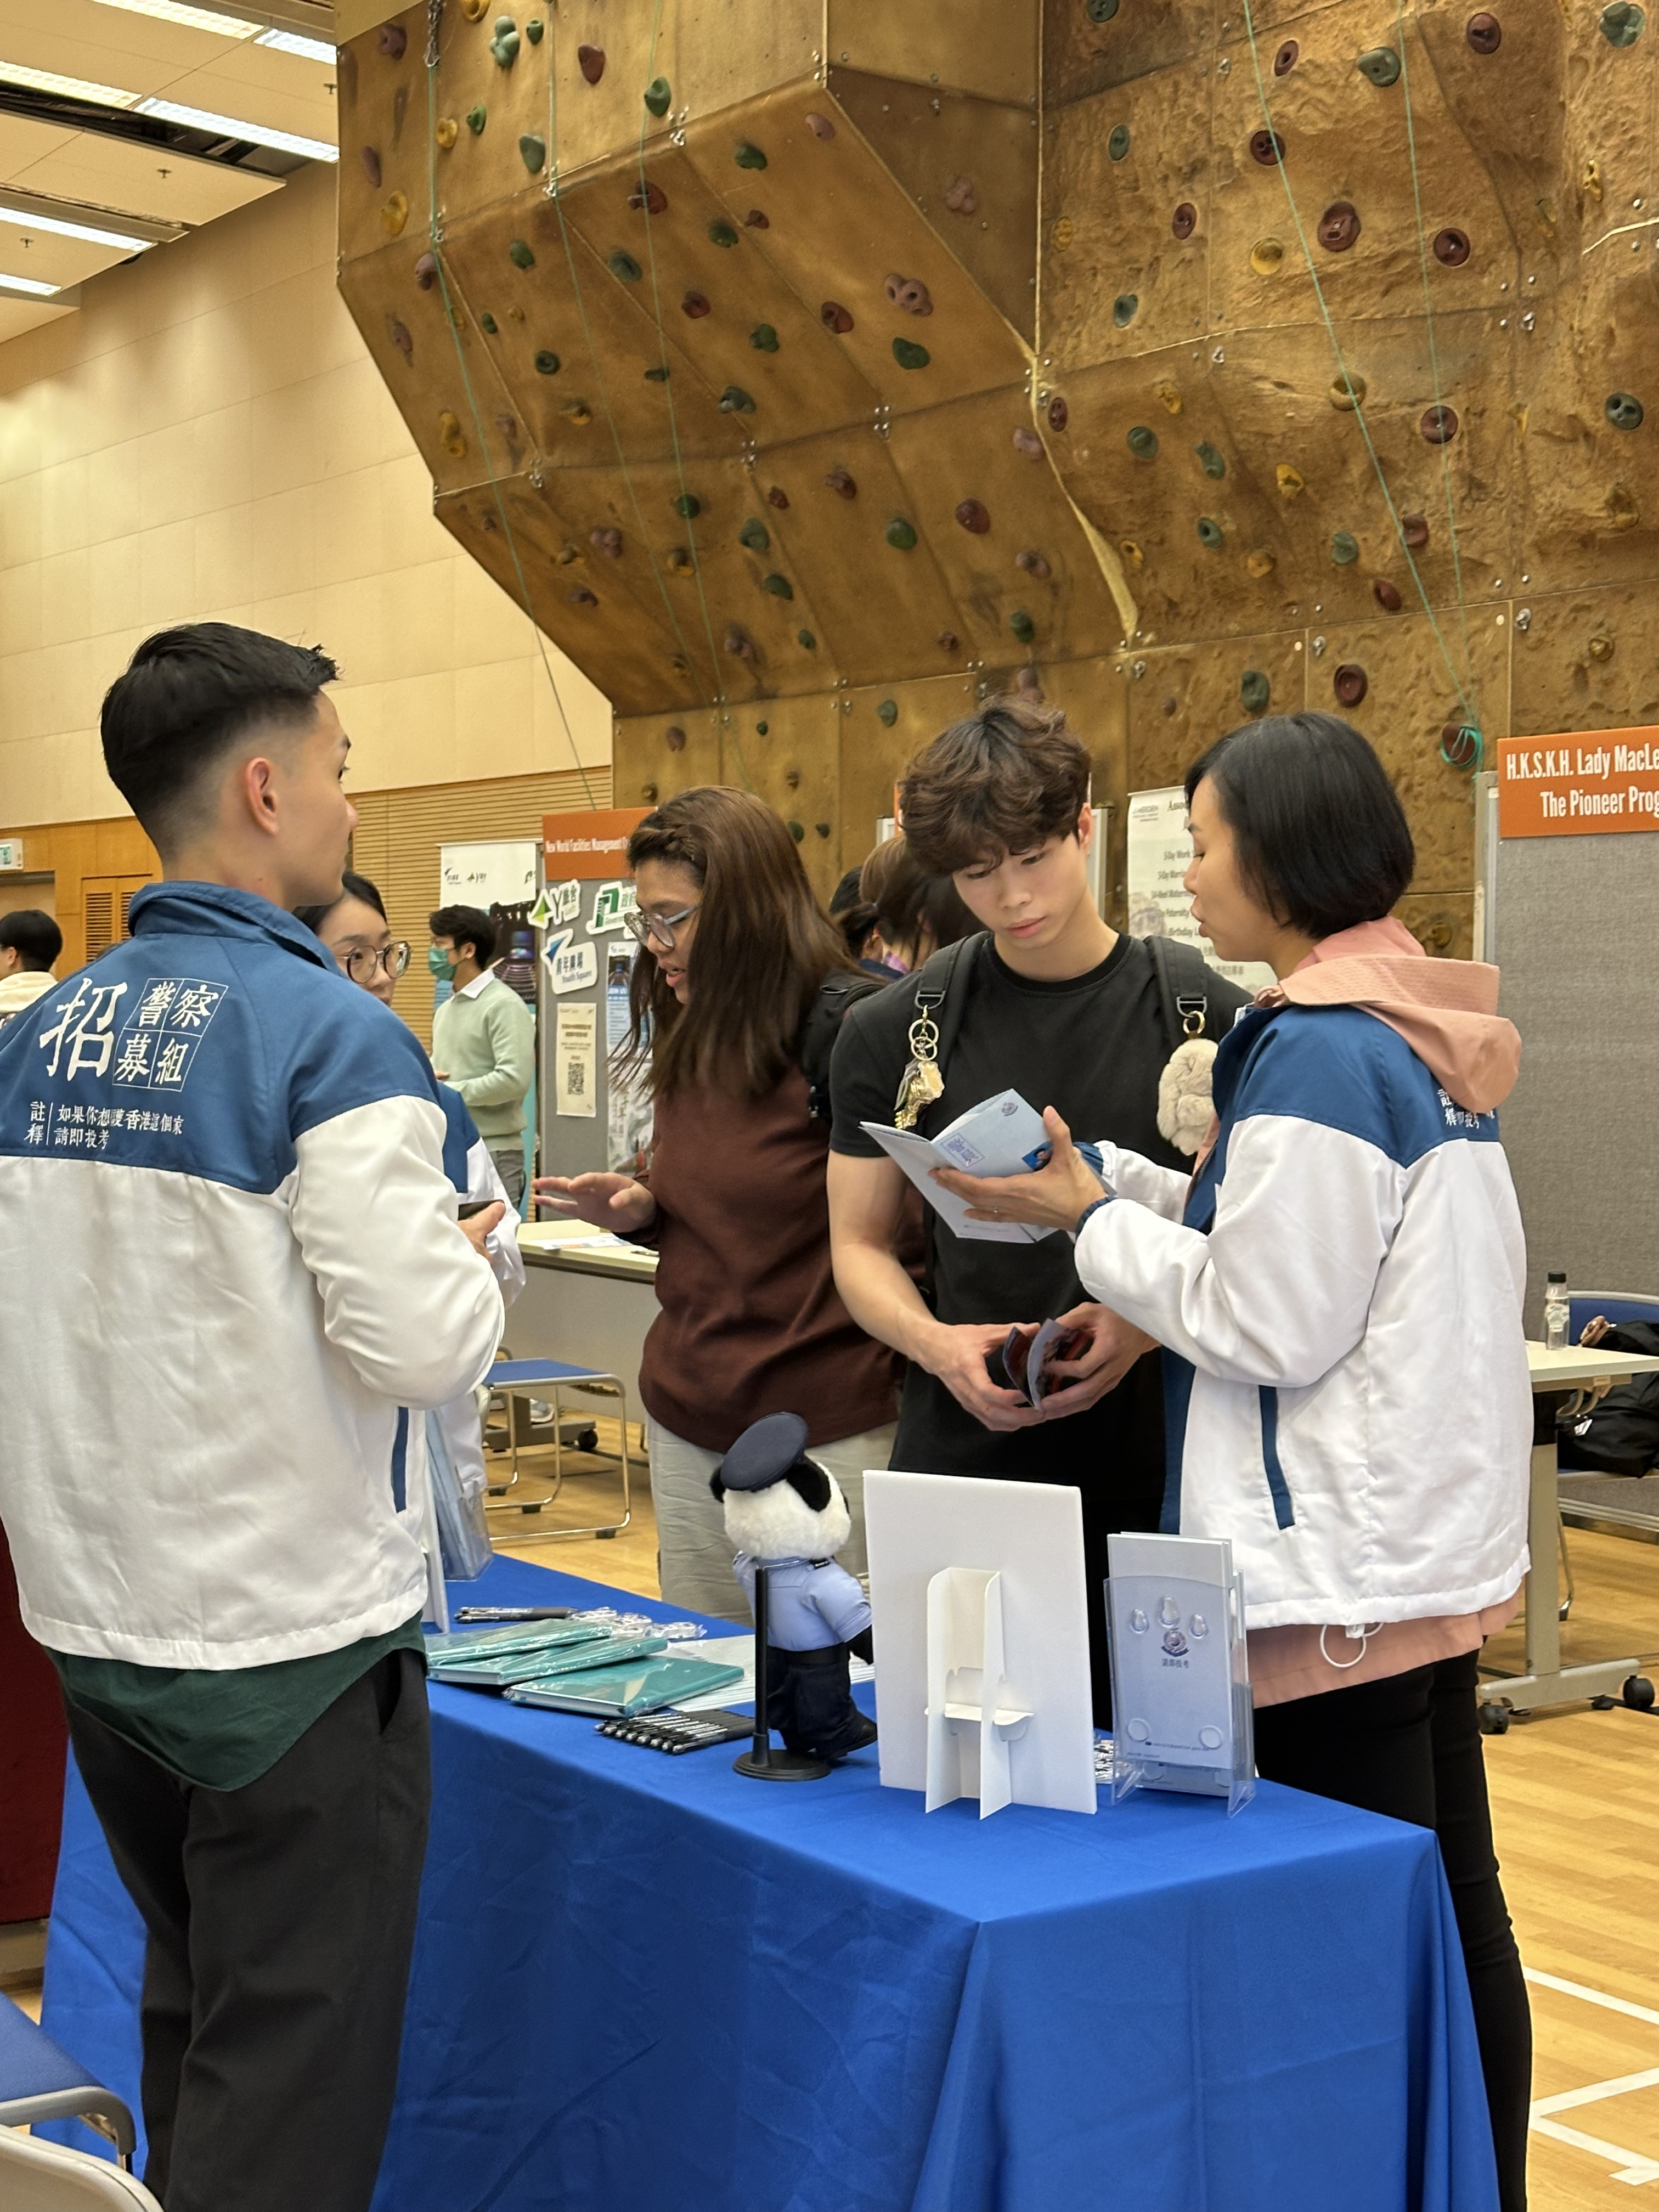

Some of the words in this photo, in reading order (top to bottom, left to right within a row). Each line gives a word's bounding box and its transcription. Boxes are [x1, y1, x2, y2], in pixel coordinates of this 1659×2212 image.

[1506, 749, 1574, 780] H.K.S.K.H.
[1577, 746, 1611, 780] Lady
[1540, 791, 1566, 817] The
[1570, 789, 1625, 816] Pioneer
[138, 980, 219, 1028] 警察
[40, 978, 128, 1082] 招
[114, 1034, 189, 1085] 募組
[54, 1126, 110, 1150] 請即投考
